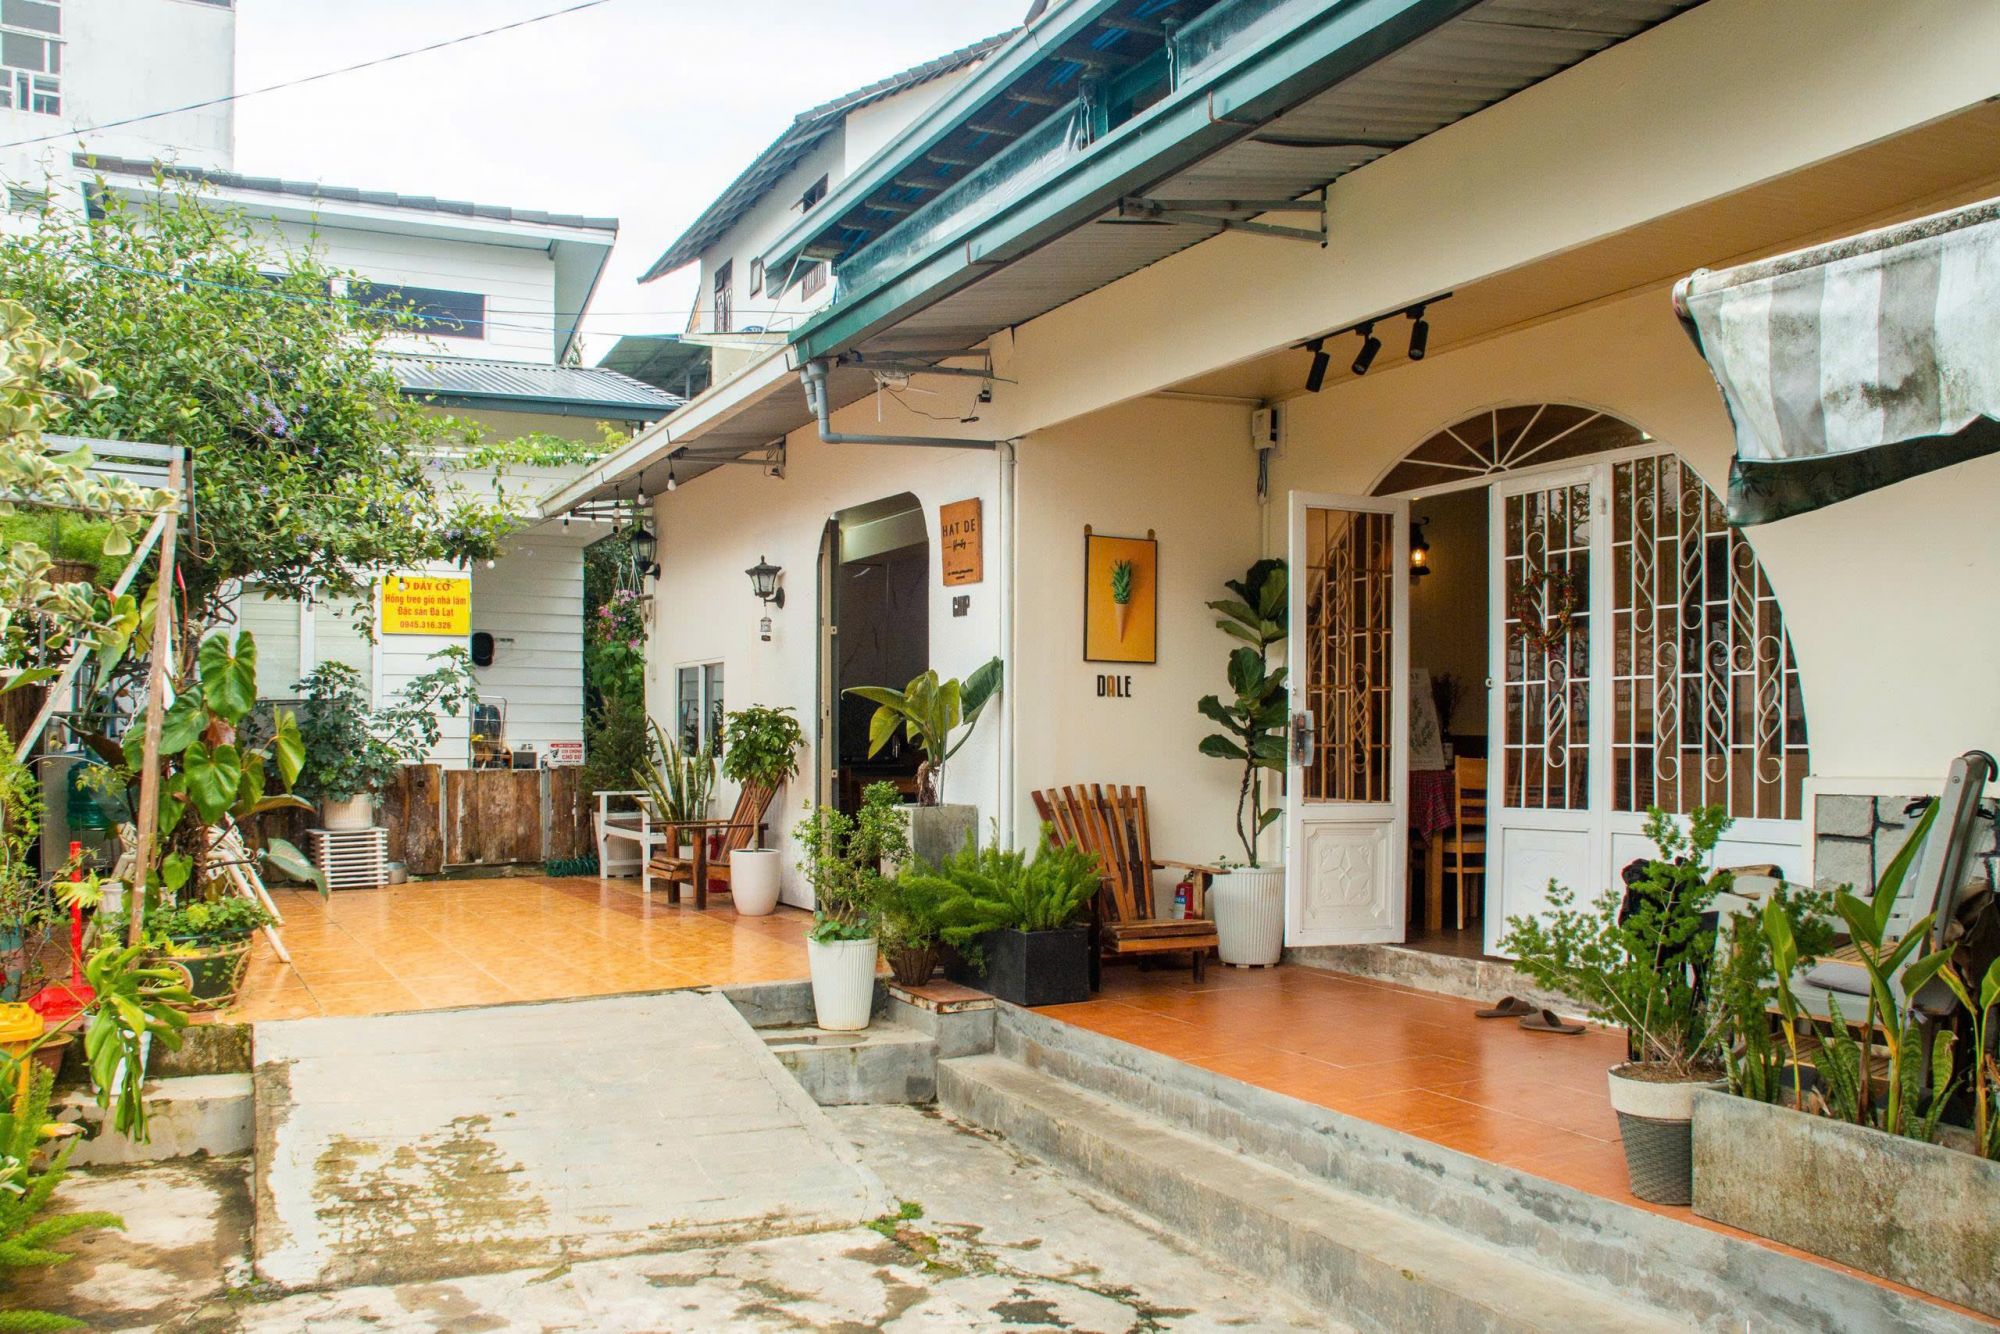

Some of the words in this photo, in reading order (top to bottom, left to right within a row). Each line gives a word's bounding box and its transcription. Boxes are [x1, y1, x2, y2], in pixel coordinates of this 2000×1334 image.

[942, 522, 959, 538] HAT
[963, 518, 976, 533] DE
[1096, 674, 1132, 698] DALE
